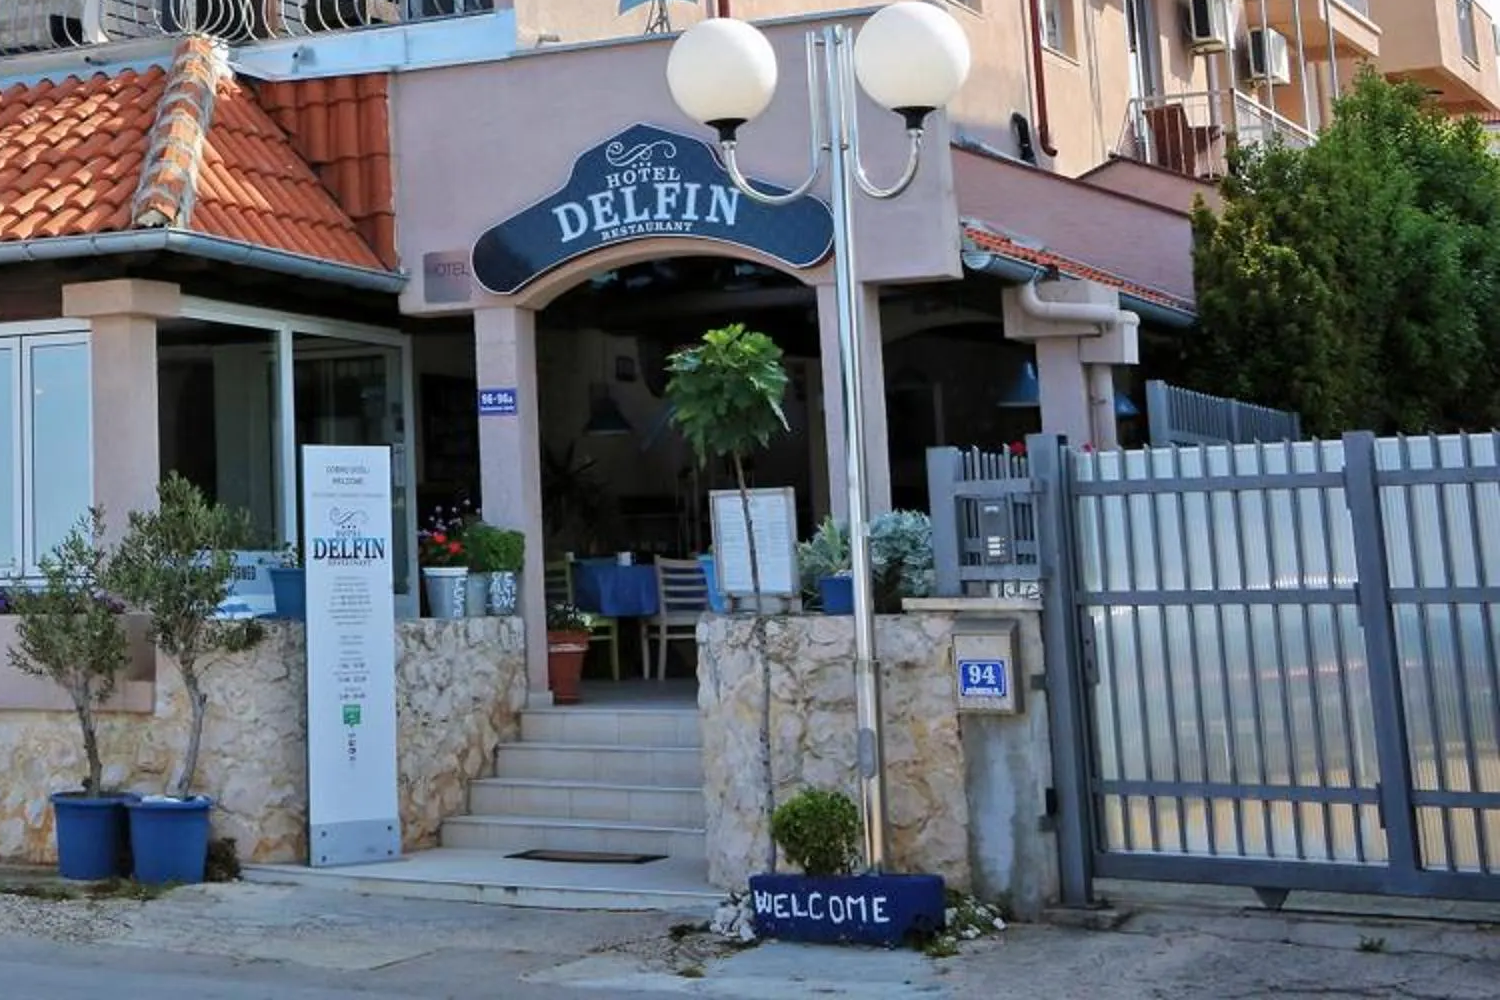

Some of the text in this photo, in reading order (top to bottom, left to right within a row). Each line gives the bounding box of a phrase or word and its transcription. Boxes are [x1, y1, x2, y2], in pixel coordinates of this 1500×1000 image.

[605, 166, 681, 189] HOTEL
[551, 182, 741, 243] DELFIN
[601, 220, 694, 241] RESTAURANT
[312, 537, 385, 560] DELFIN
[968, 664, 997, 685] 94
[753, 890, 890, 924] WELCOME
